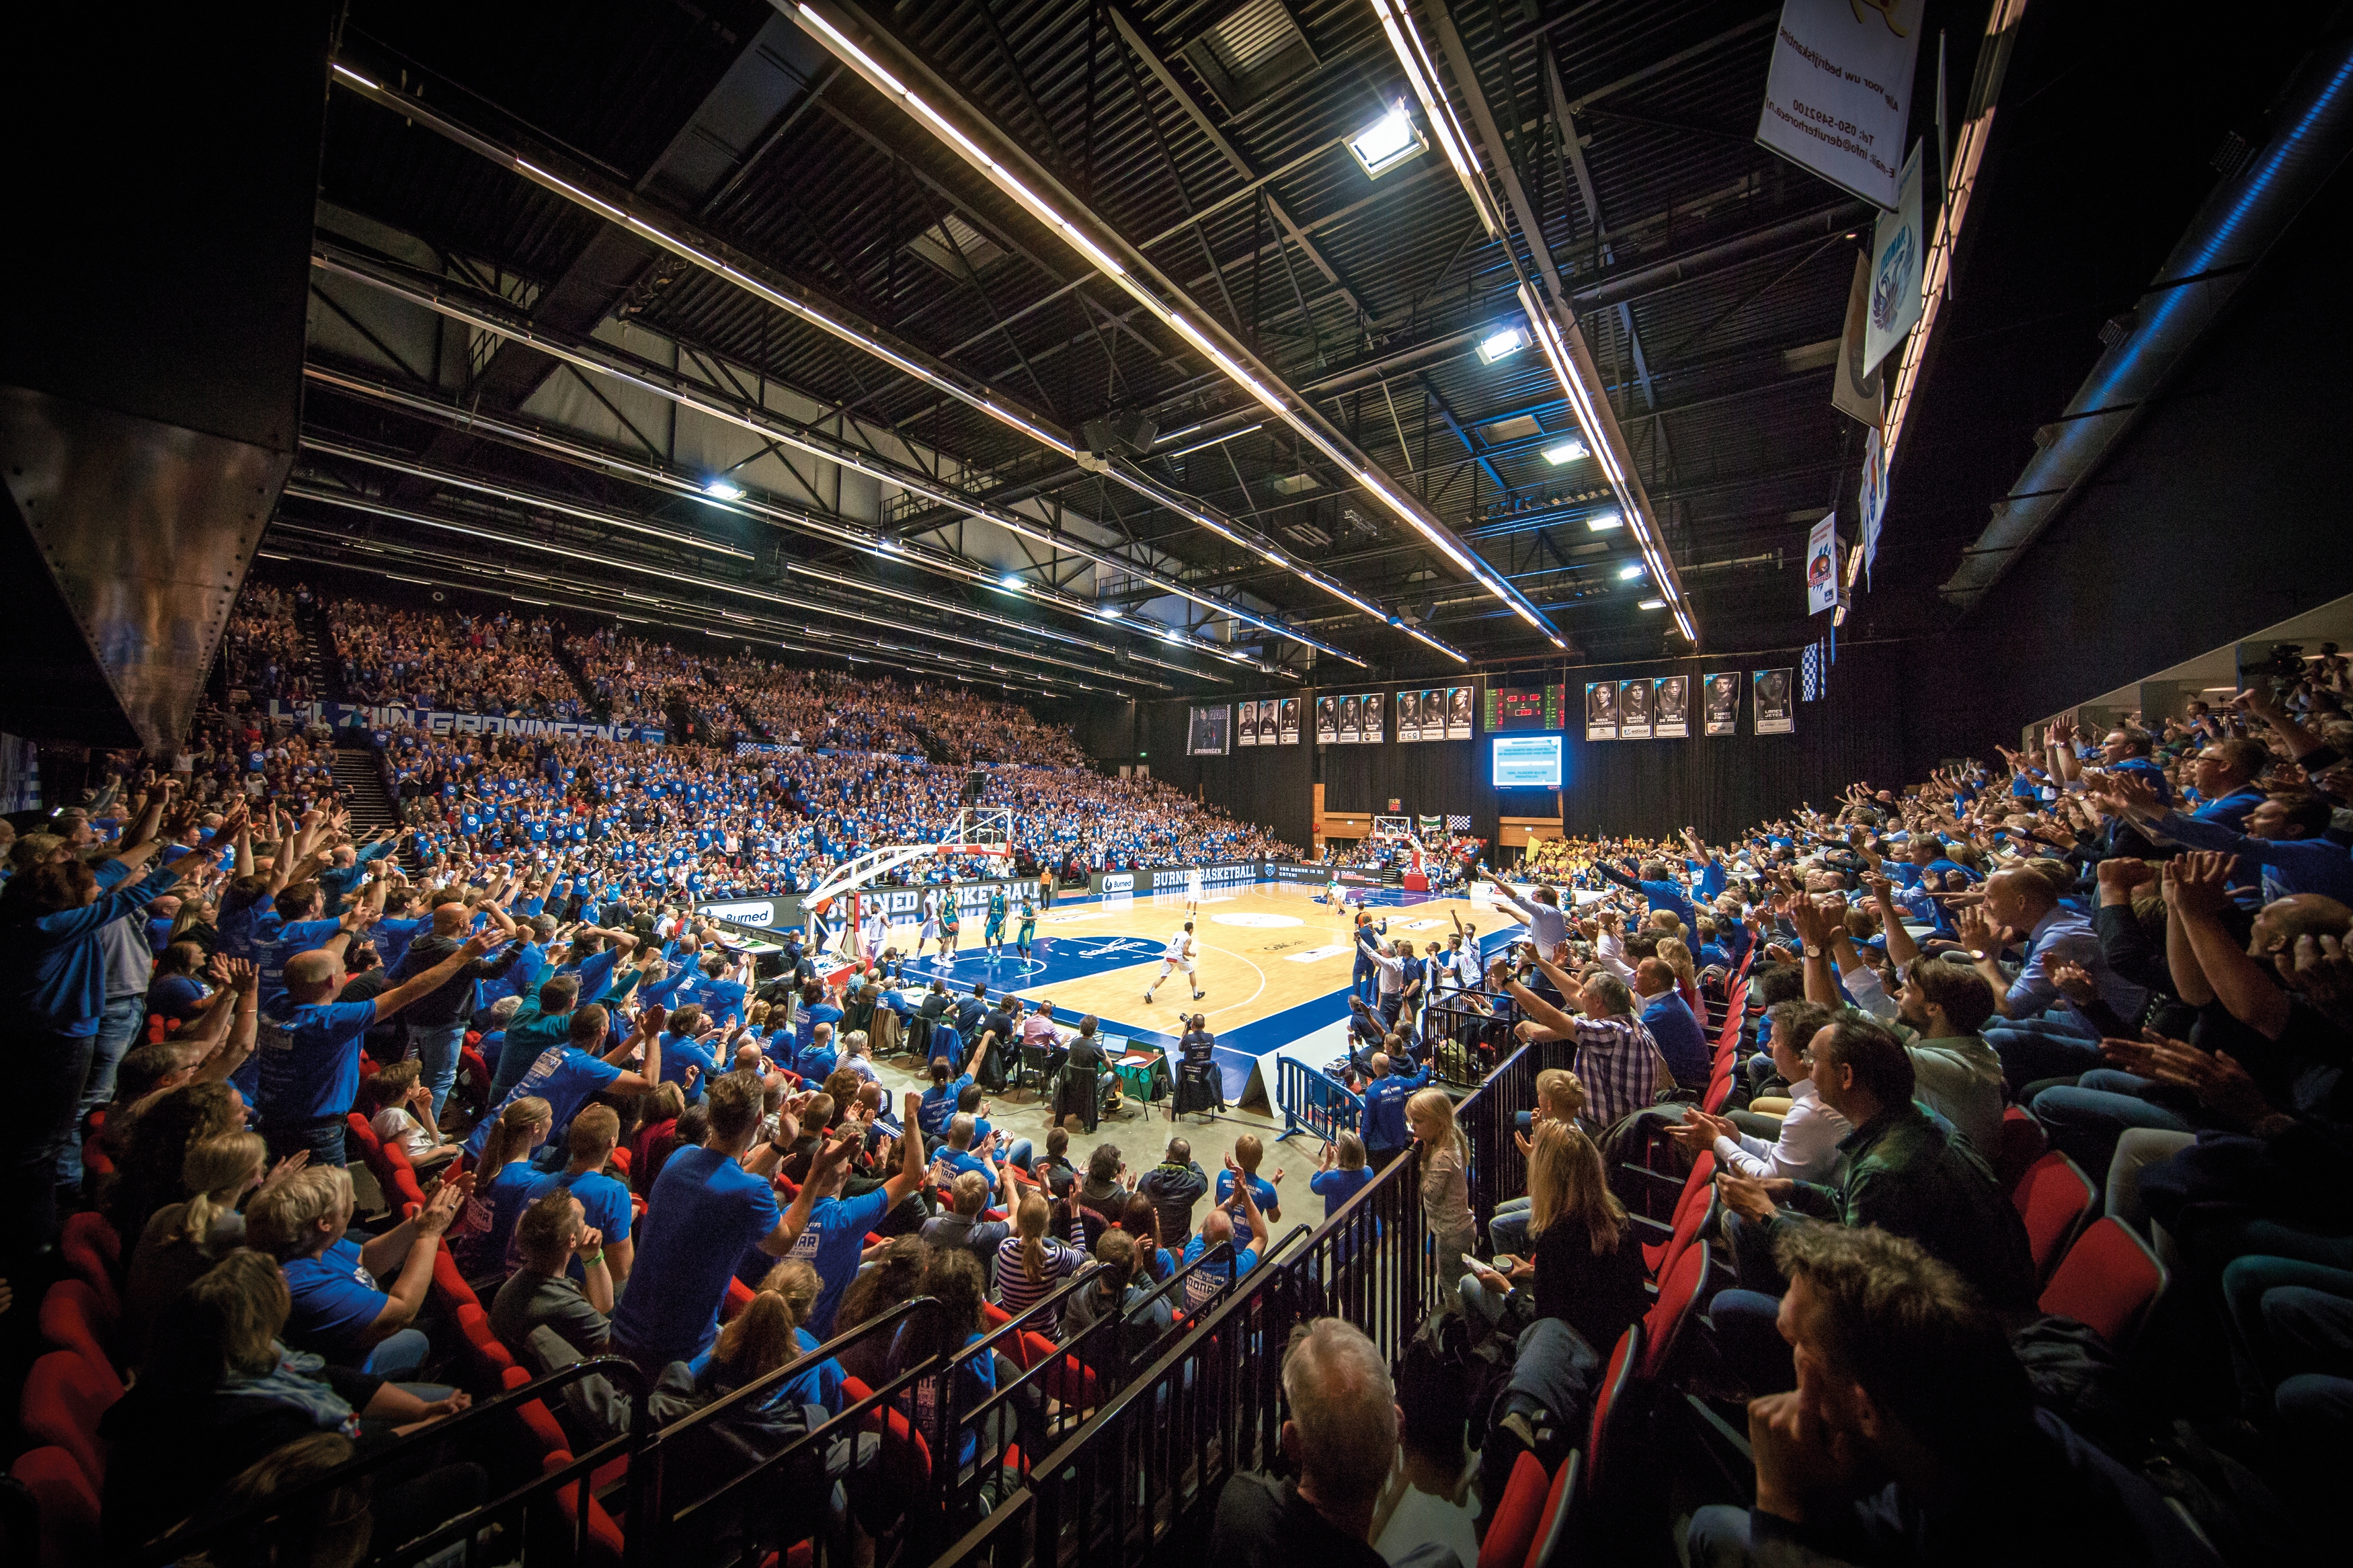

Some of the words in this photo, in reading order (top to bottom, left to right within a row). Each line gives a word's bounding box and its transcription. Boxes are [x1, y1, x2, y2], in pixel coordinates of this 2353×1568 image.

[616, 623, 623, 631] P
[746, 645, 752, 653] R
[1193, 709, 1226, 721] DNAR
[1153, 866, 1192, 888] BURNE
[1200, 864, 1257, 882] BASKETBALL
[1114, 879, 1131, 888] Burned
[928, 882, 1041, 907] BAKETBALL
[1188, 1277, 1217, 1294] DONA
